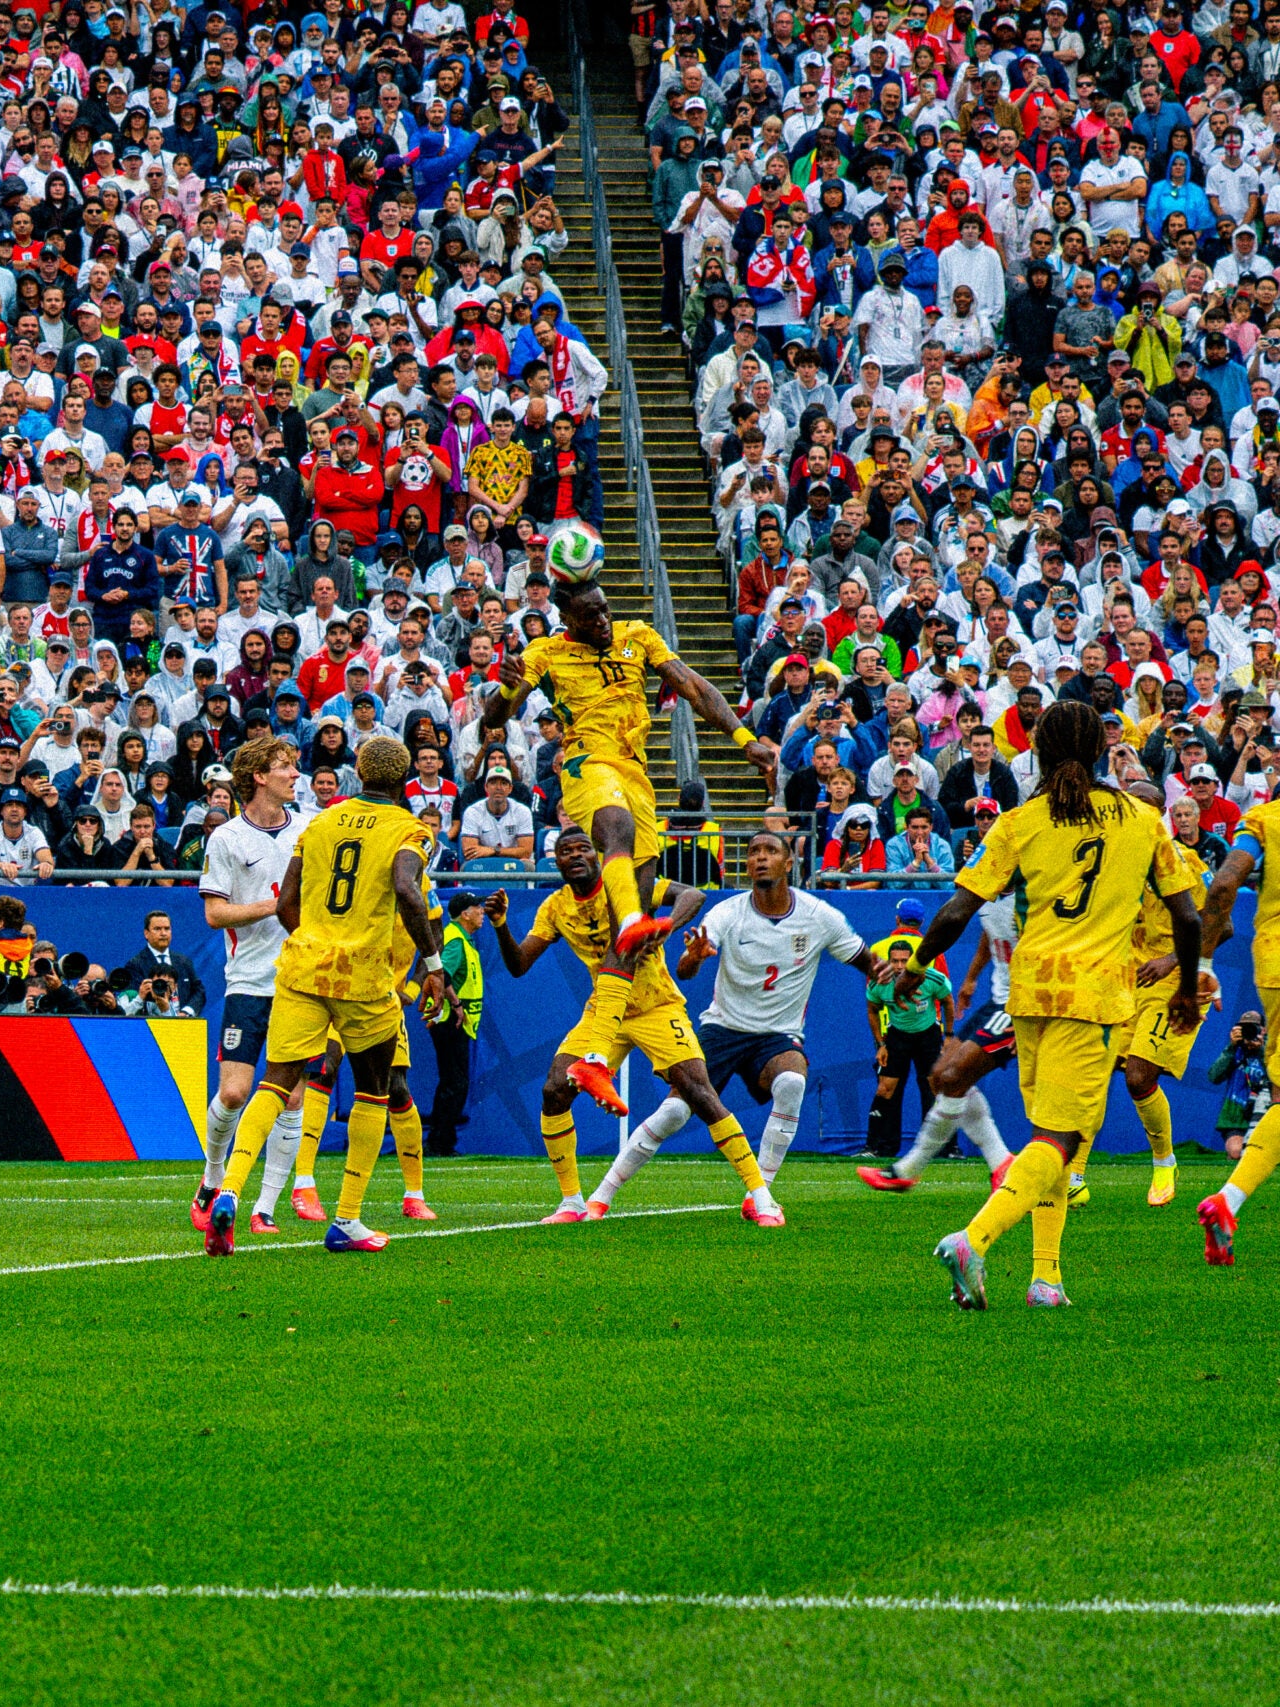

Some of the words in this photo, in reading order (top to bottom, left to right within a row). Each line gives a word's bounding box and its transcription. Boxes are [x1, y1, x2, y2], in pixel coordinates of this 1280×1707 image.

[227, 159, 262, 170] MIAMI
[102, 567, 134, 581] ORCHARD
[317, 667, 329, 684] 9
[337, 813, 378, 830] SIBO
[324, 837, 365, 919] 8
[1052, 832, 1106, 925] 3
[762, 965, 780, 992] 2
[669, 1019, 685, 1040] 5
[984, 1010, 1012, 1036] 10
[1149, 1012, 1170, 1041] 11
[1036, 1200, 1055, 1208] ANA
